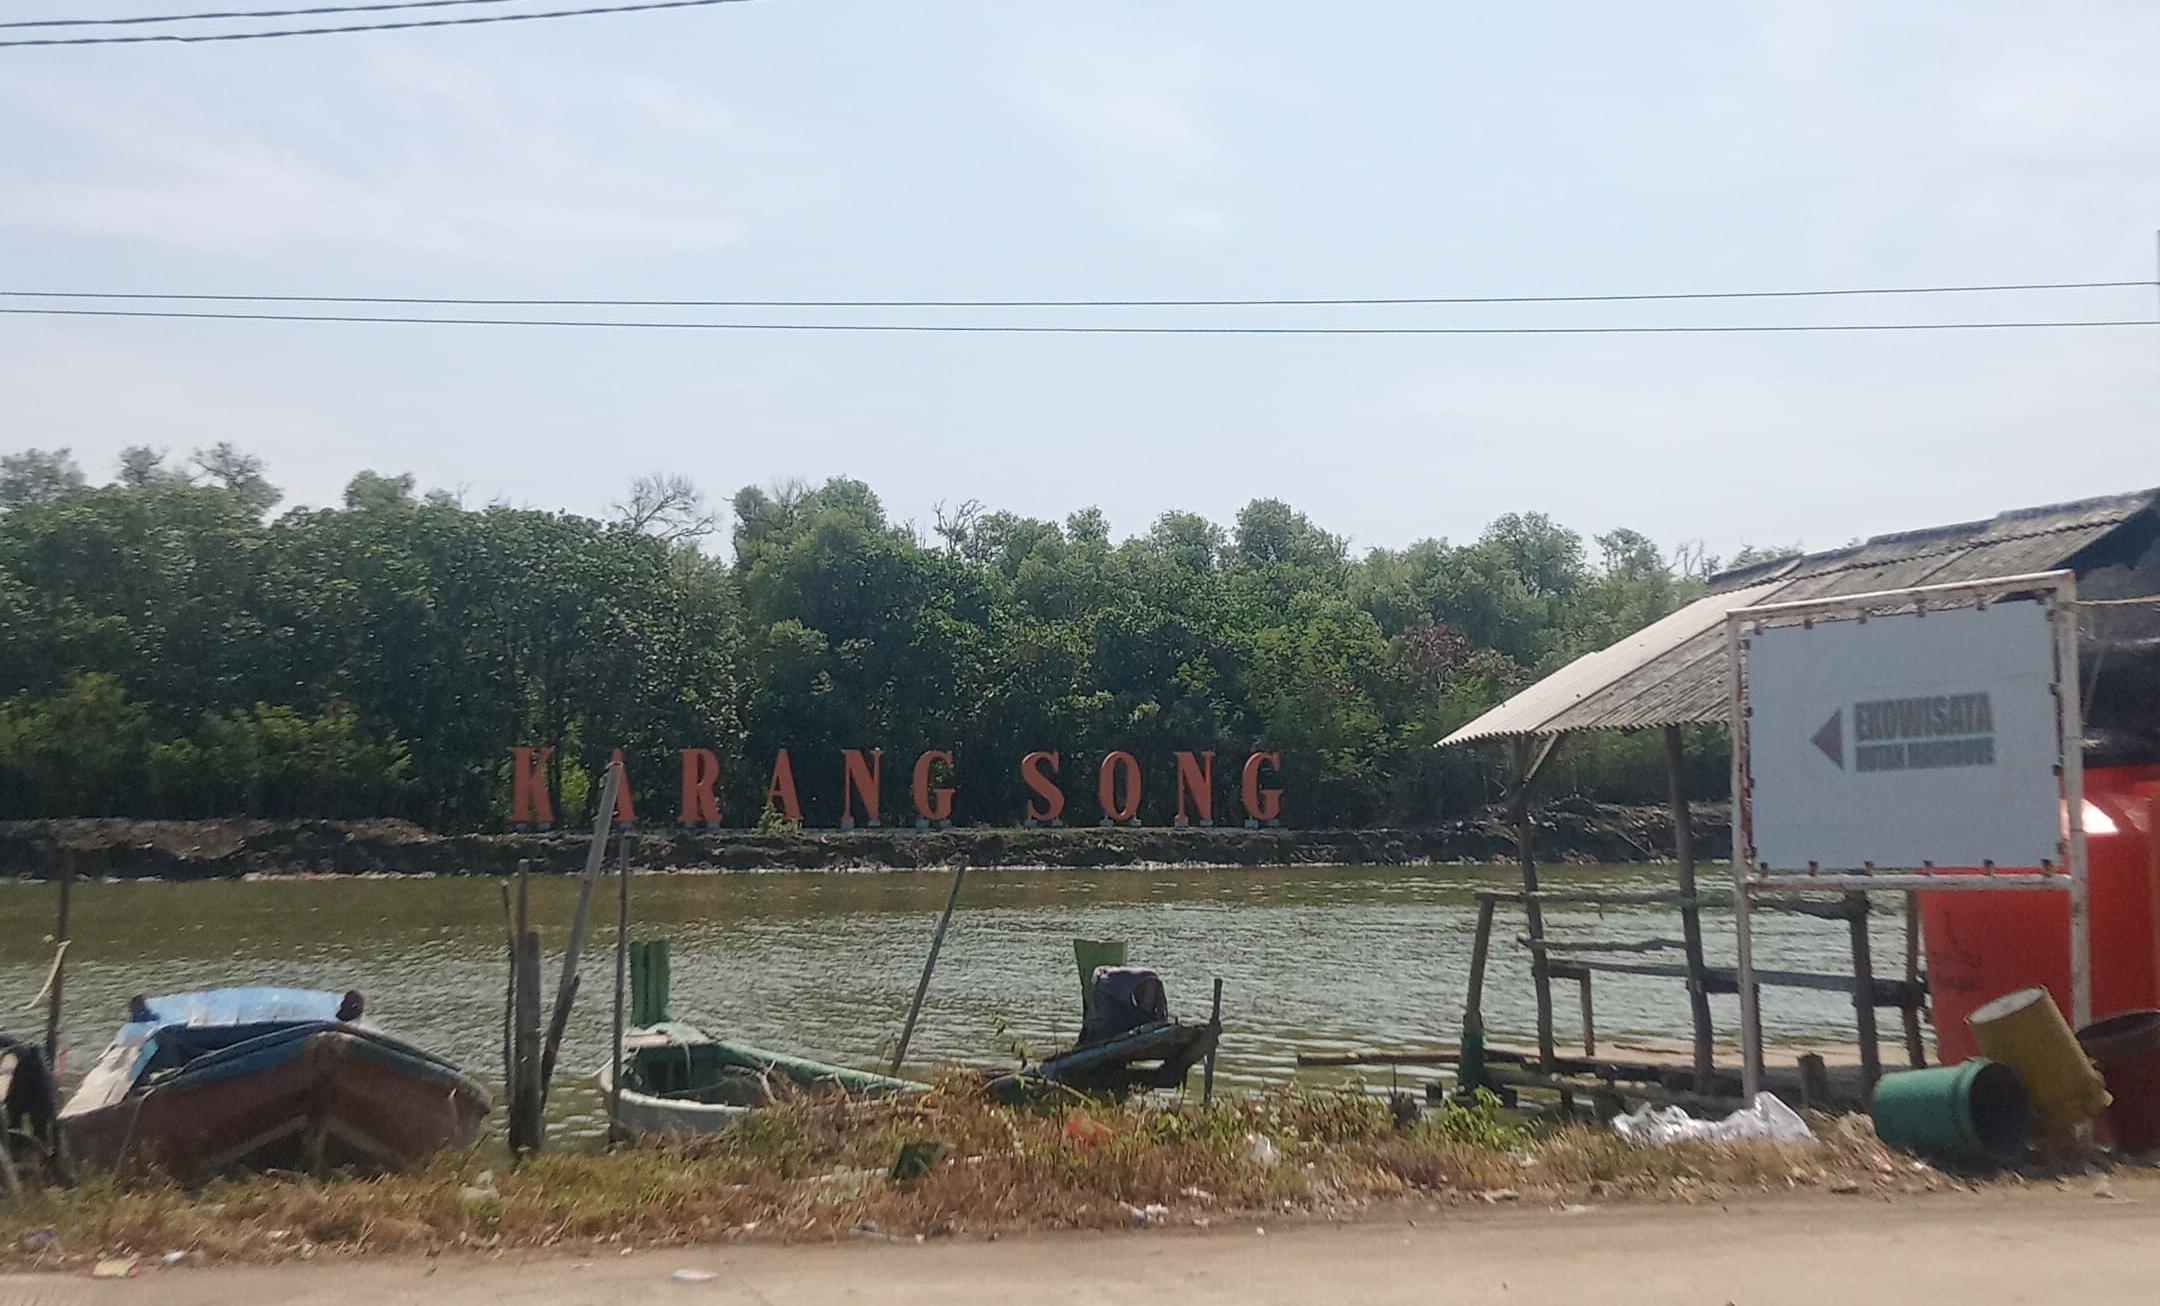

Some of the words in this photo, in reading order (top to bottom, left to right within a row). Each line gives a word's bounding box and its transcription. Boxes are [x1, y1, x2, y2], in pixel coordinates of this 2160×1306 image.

[1855, 693, 1993, 741] EKOWISATA
[510, 746, 957, 823] KARANG
[1020, 750, 1283, 822] SONG
